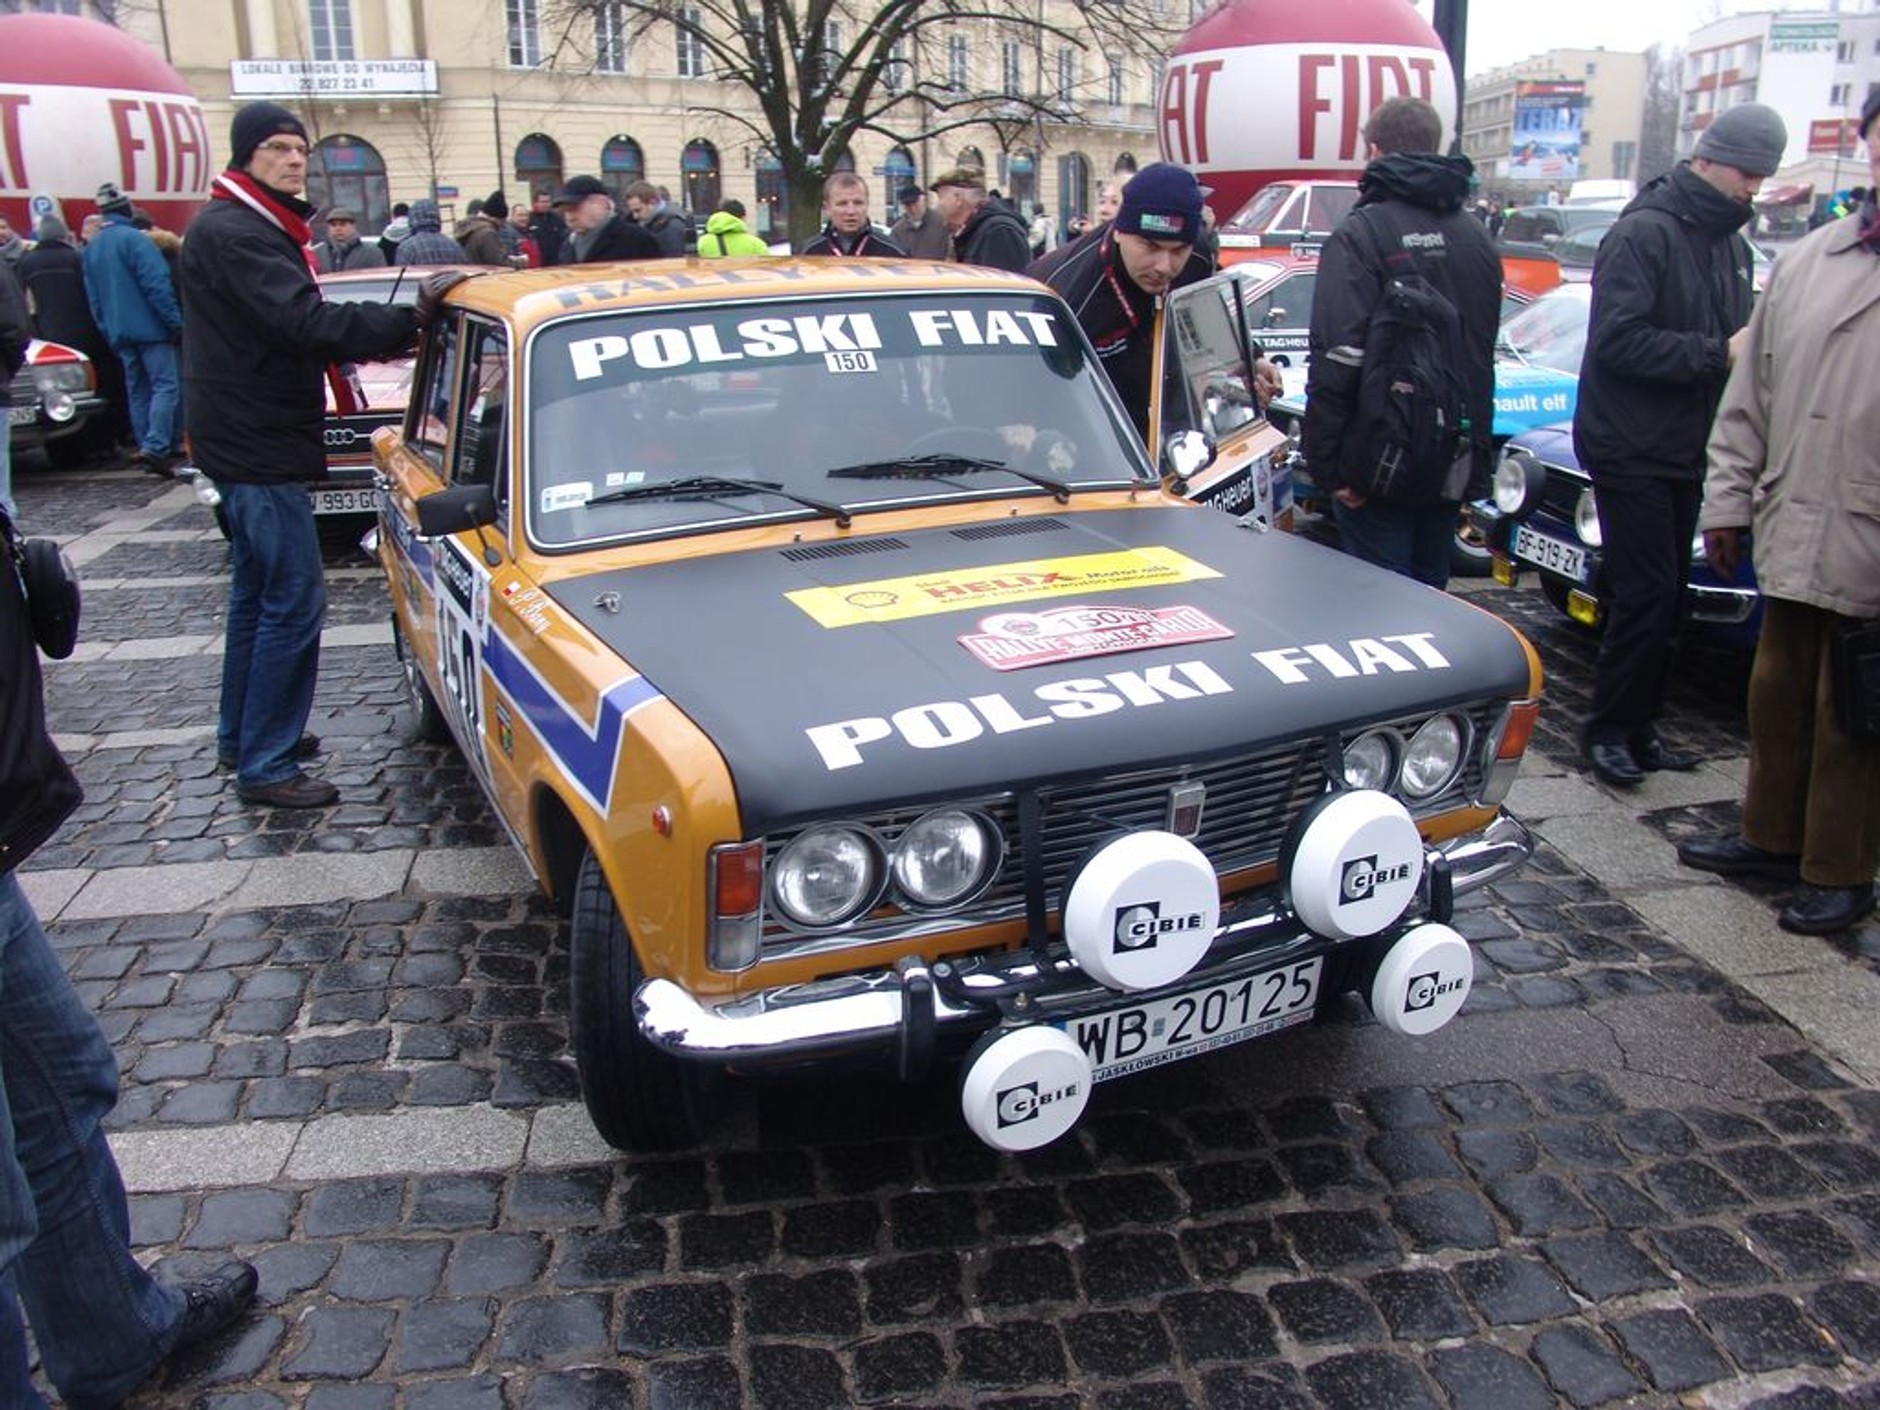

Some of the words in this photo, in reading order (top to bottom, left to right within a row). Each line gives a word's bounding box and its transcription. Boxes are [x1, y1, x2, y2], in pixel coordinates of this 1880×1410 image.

[1770, 41, 1818, 52] APTEKA
[241, 62, 282, 75] LOKALE
[343, 62, 359, 74] DO
[1298, 54, 1436, 161] FIAT
[568, 312, 884, 380] POLSKI
[907, 308, 1060, 348] FIAT
[832, 352, 870, 371] 150
[1542, 394, 1567, 411] elf
[924, 572, 1063, 598] HELIX
[1058, 611, 1122, 630] 150
[805, 660, 1235, 770] POLSKI
[1251, 633, 1452, 685] FIAT
[1077, 1009, 1147, 1065] WB
[1167, 962, 1315, 1046] 20125
[1098, 1051, 1175, 1082] JASKŁOWSKI
